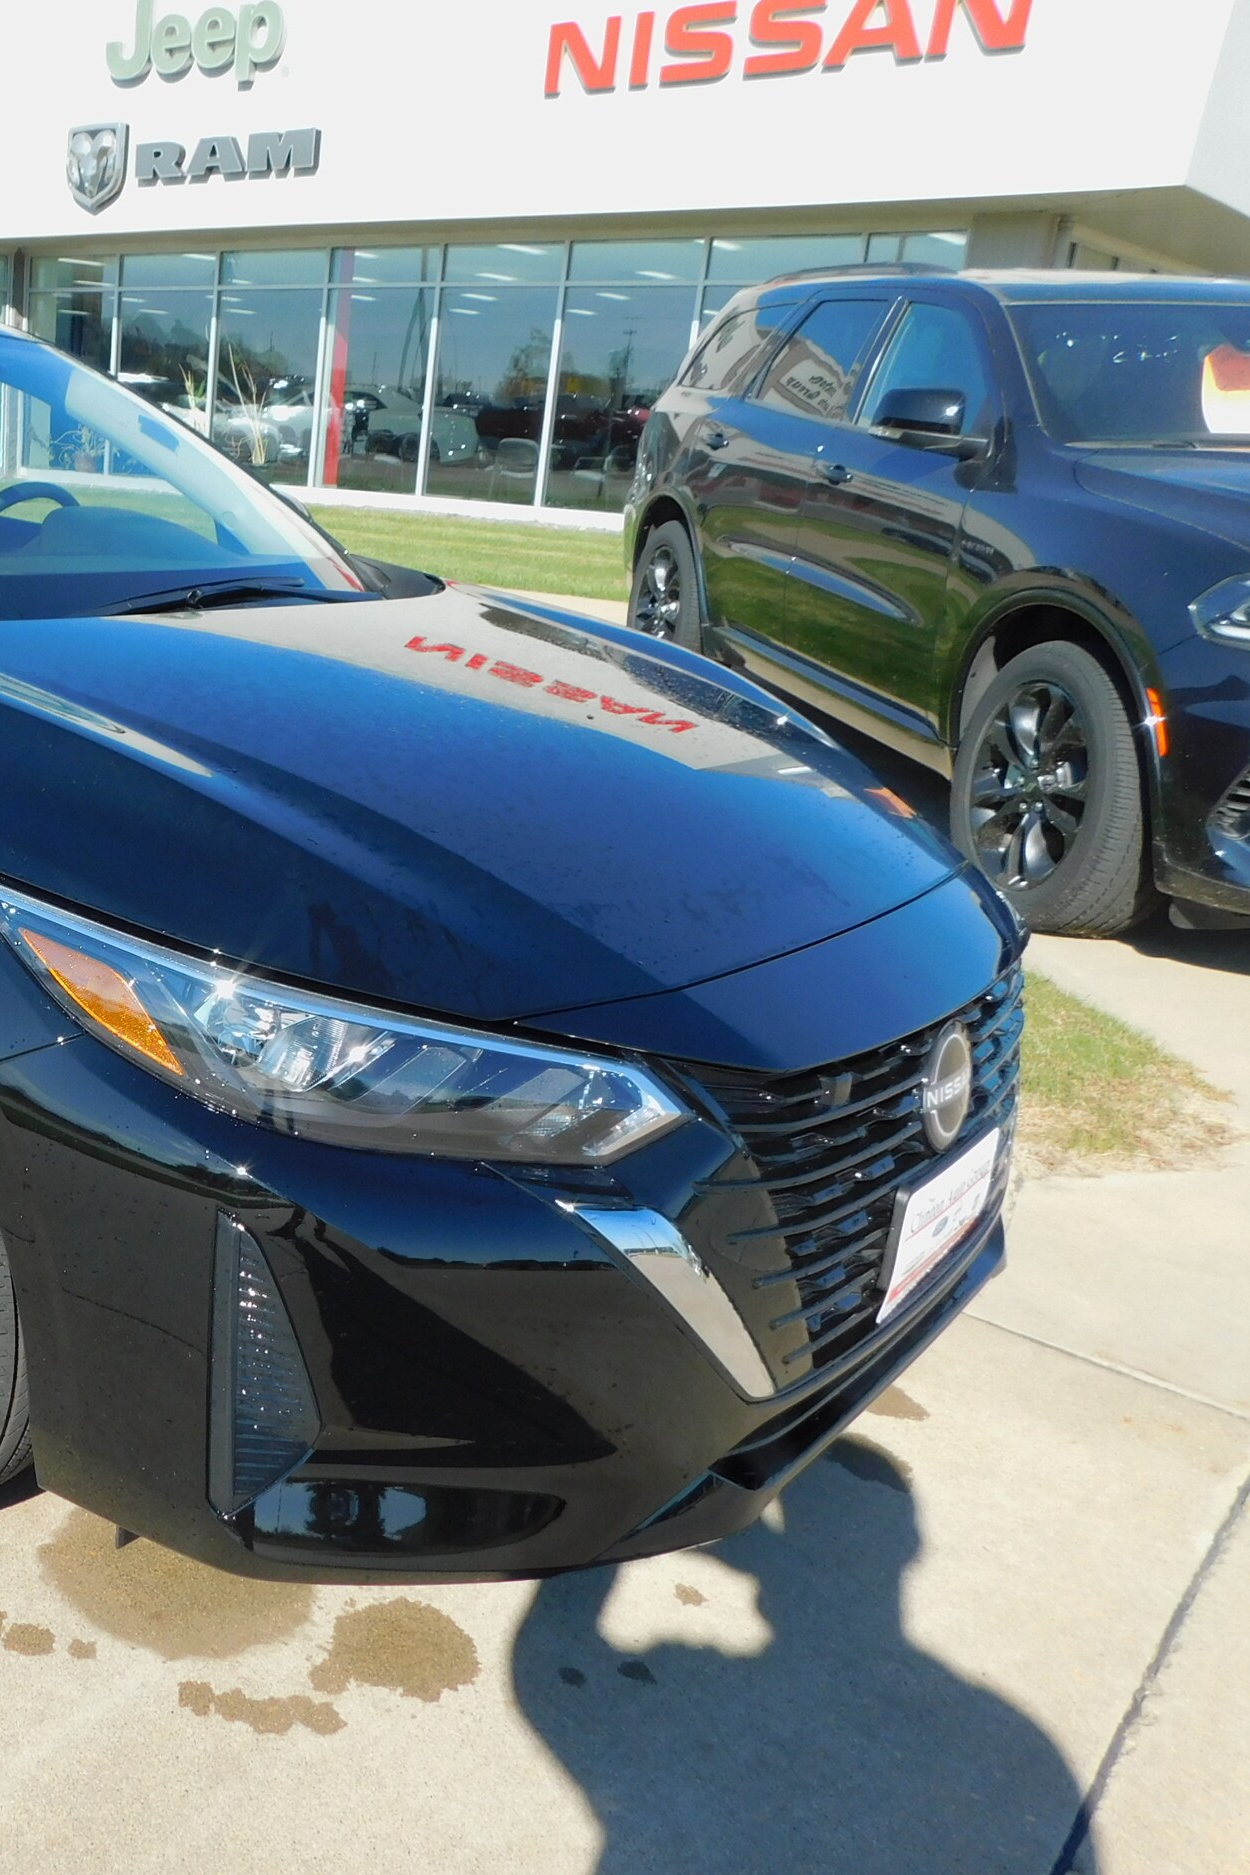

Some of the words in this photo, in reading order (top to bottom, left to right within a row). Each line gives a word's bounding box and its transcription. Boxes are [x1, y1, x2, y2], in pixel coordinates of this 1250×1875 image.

[105, 0, 284, 91] Jeep
[543, 0, 1034, 99] NISSAN
[135, 127, 322, 187] RAM
